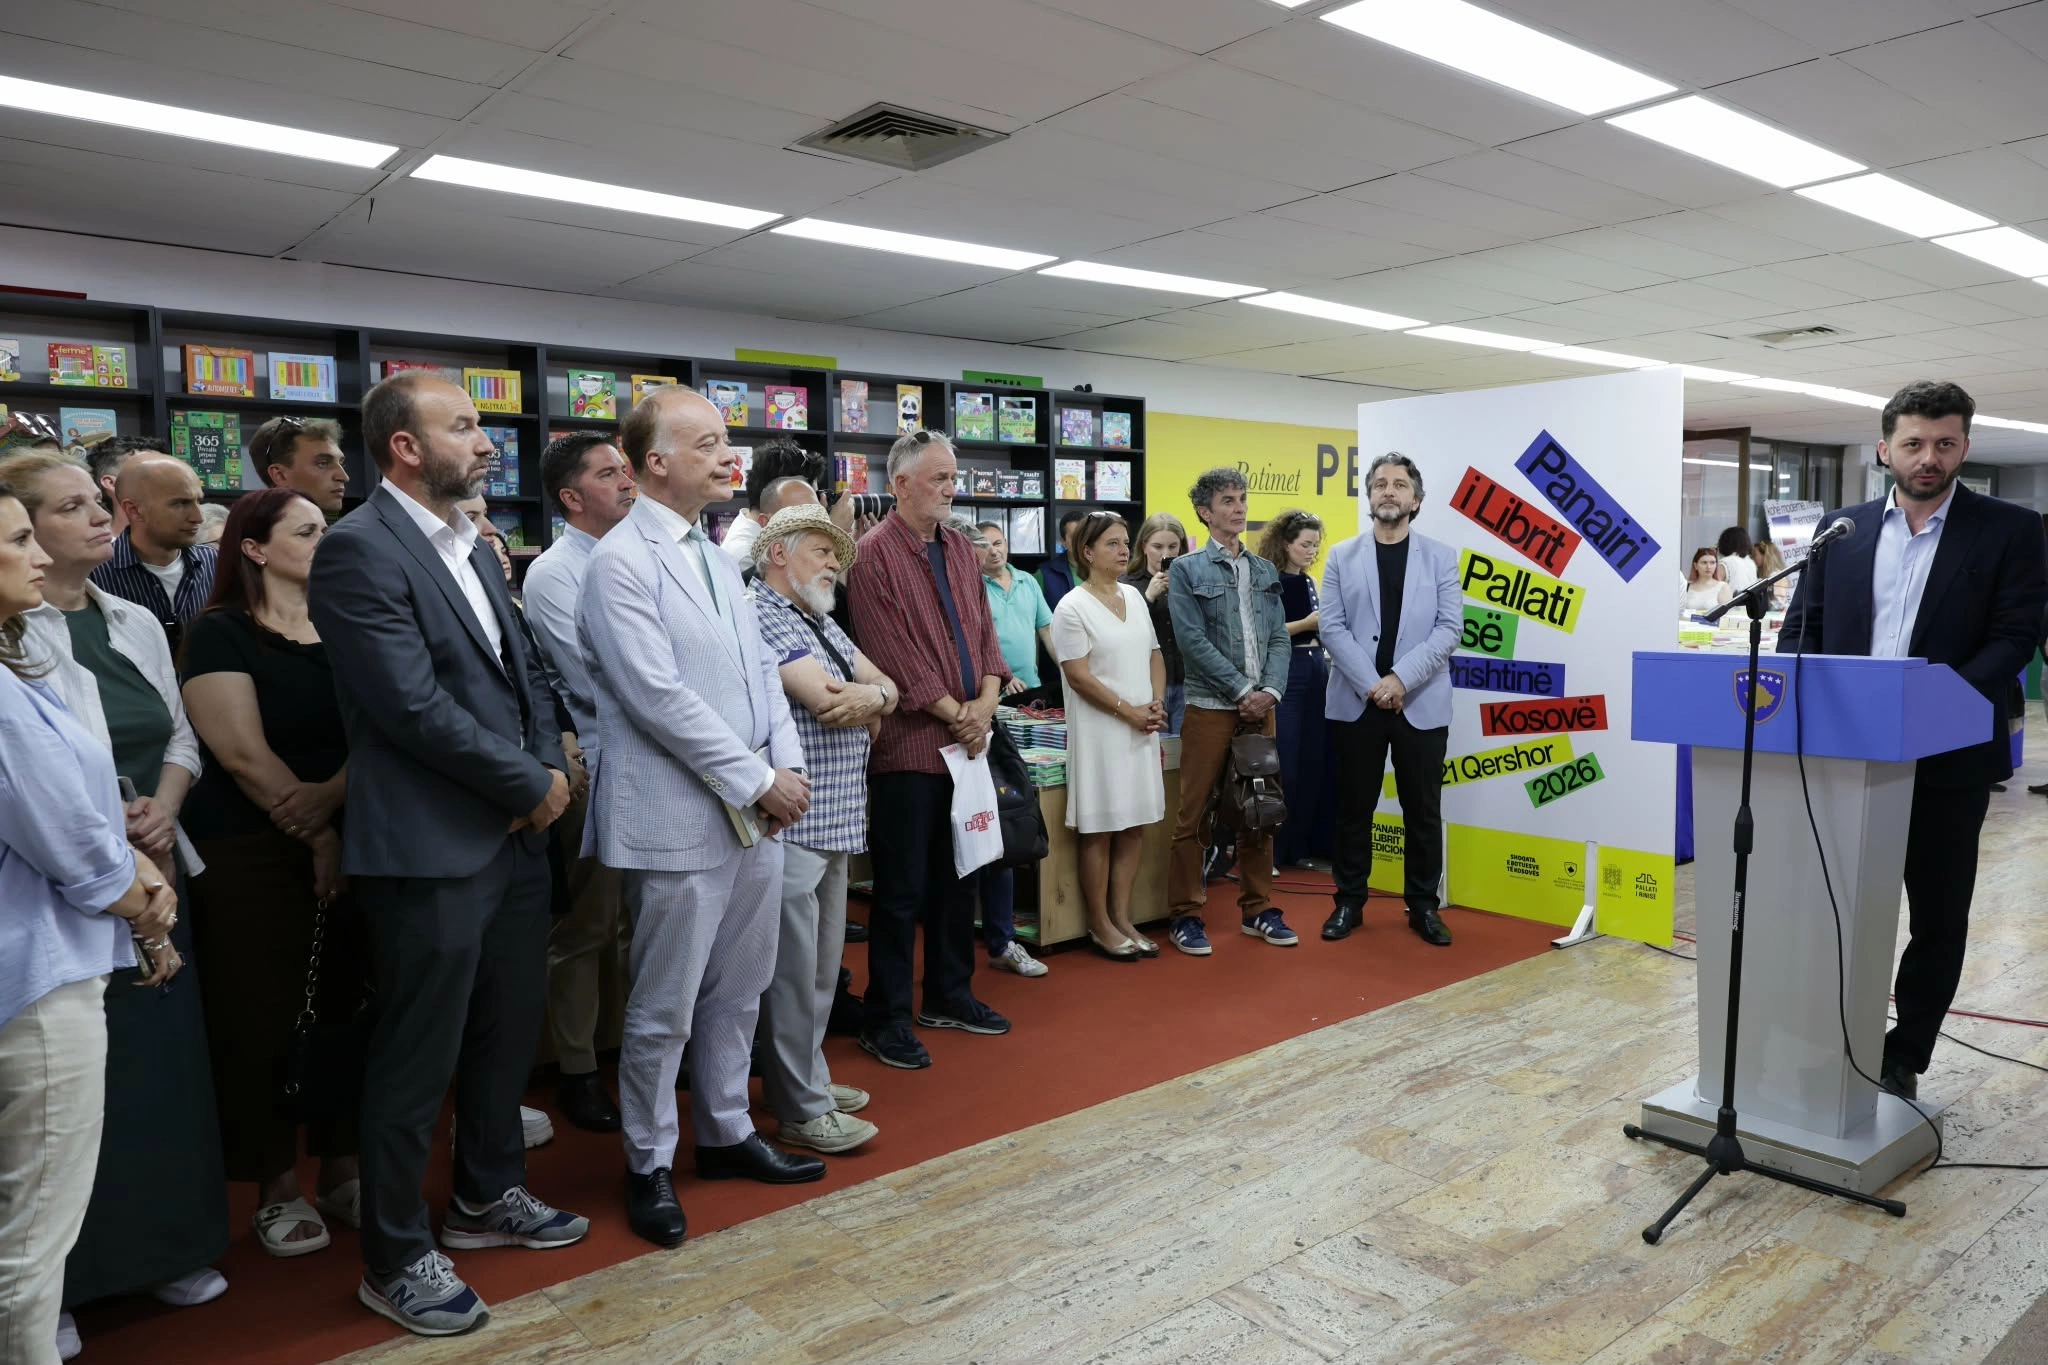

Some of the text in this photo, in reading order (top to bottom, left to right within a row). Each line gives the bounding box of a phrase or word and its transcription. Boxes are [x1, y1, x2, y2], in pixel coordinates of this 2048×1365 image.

[194, 434, 220, 447] 365
[1460, 475, 1566, 569] i Librit
[1526, 441, 1648, 570] Panairi
[1462, 553, 1575, 627] Pallati
[1489, 698, 1597, 733] Kosovë
[1461, 744, 1554, 779] Qershor
[1532, 758, 1596, 804] 2026
